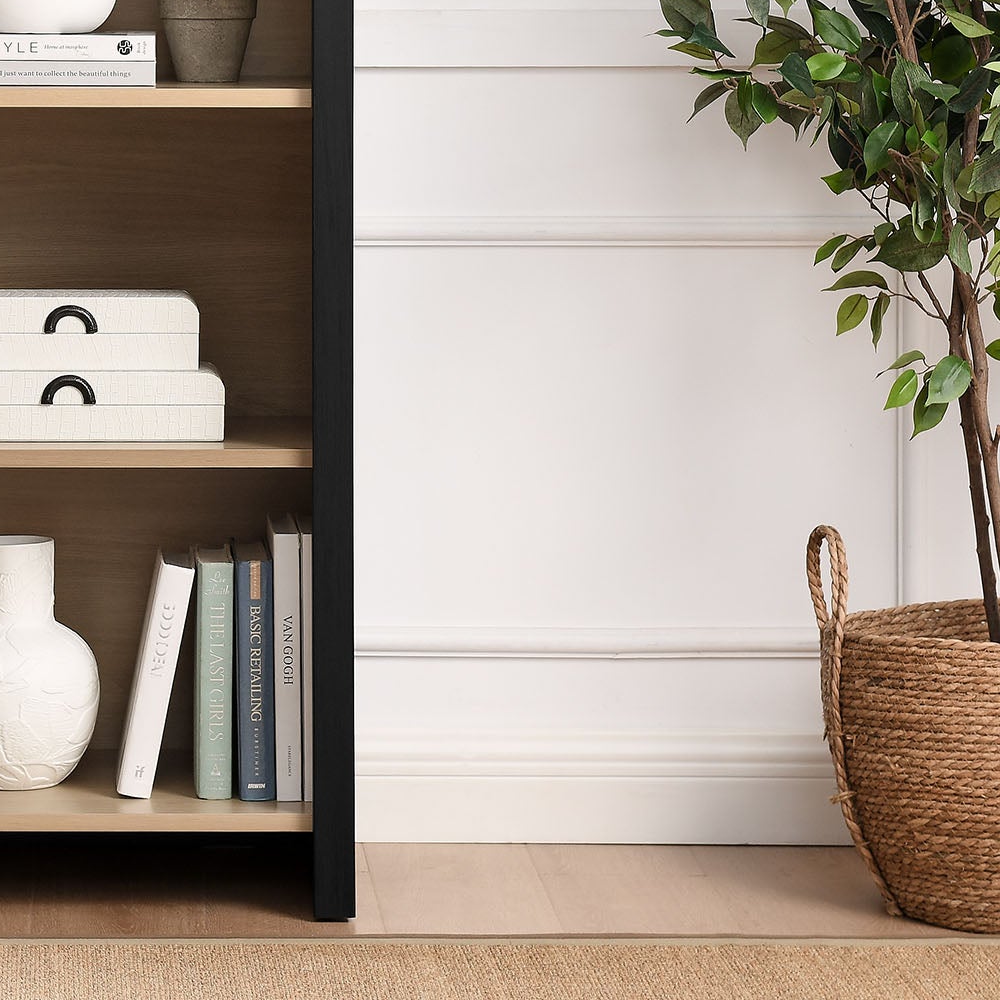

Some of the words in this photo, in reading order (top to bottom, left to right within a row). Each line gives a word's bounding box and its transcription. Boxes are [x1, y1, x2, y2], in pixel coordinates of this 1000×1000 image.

[3, 70, 16, 78] just
[78, 69, 109, 77] beautiful
[110, 69, 132, 78] things
[209, 603, 226, 639] THE
[249, 605, 262, 645] BASIC
[282, 615, 293, 643] VAN
[209, 642, 225, 686] LAST
[283, 645, 294, 685] GOGH
[250, 647, 263, 722] RETAILING
[208, 687, 225, 741] GIRLS
